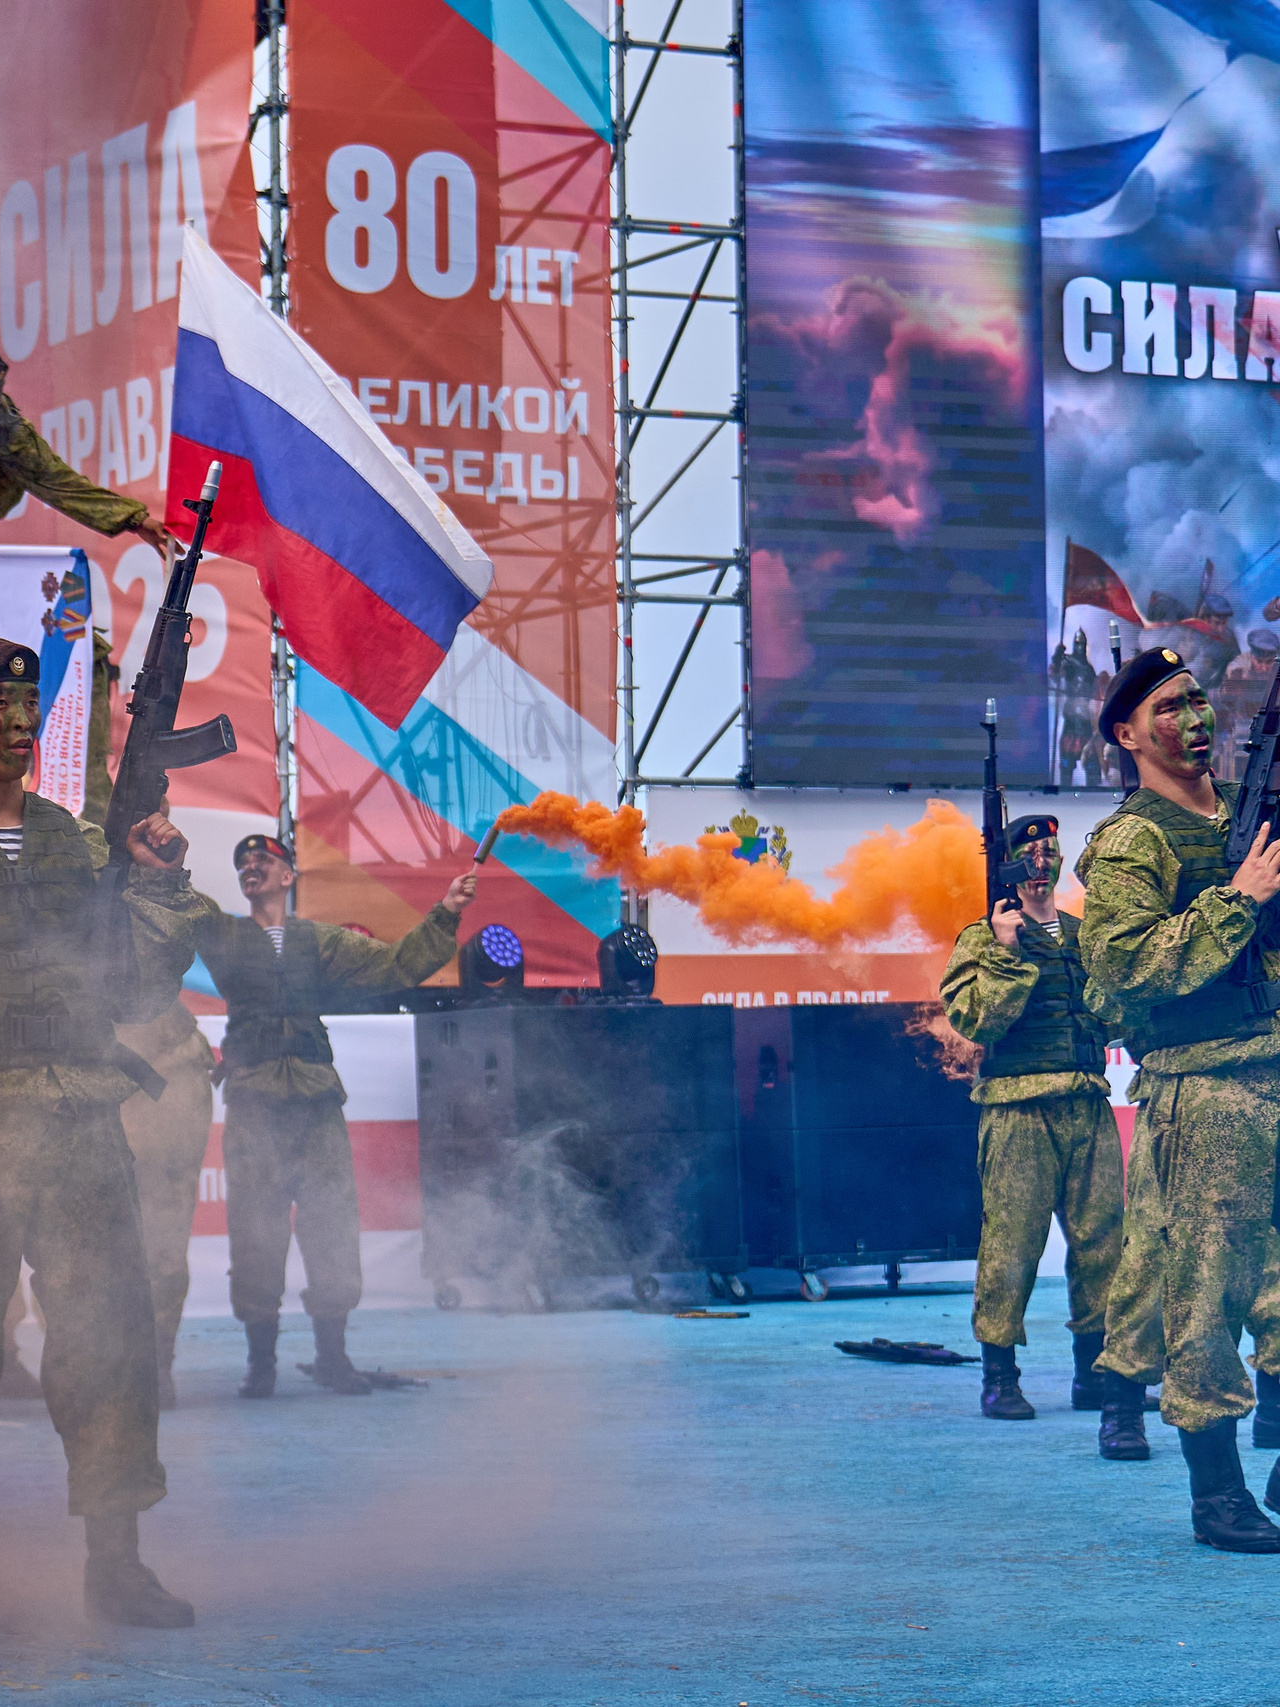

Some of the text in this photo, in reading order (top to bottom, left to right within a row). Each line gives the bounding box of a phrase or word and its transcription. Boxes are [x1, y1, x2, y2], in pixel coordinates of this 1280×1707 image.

[325, 144, 579, 307] 80 ЛЕТ
[1063, 276, 1280, 382] СИЛА
[393, 444, 580, 506] БЕДЫ
